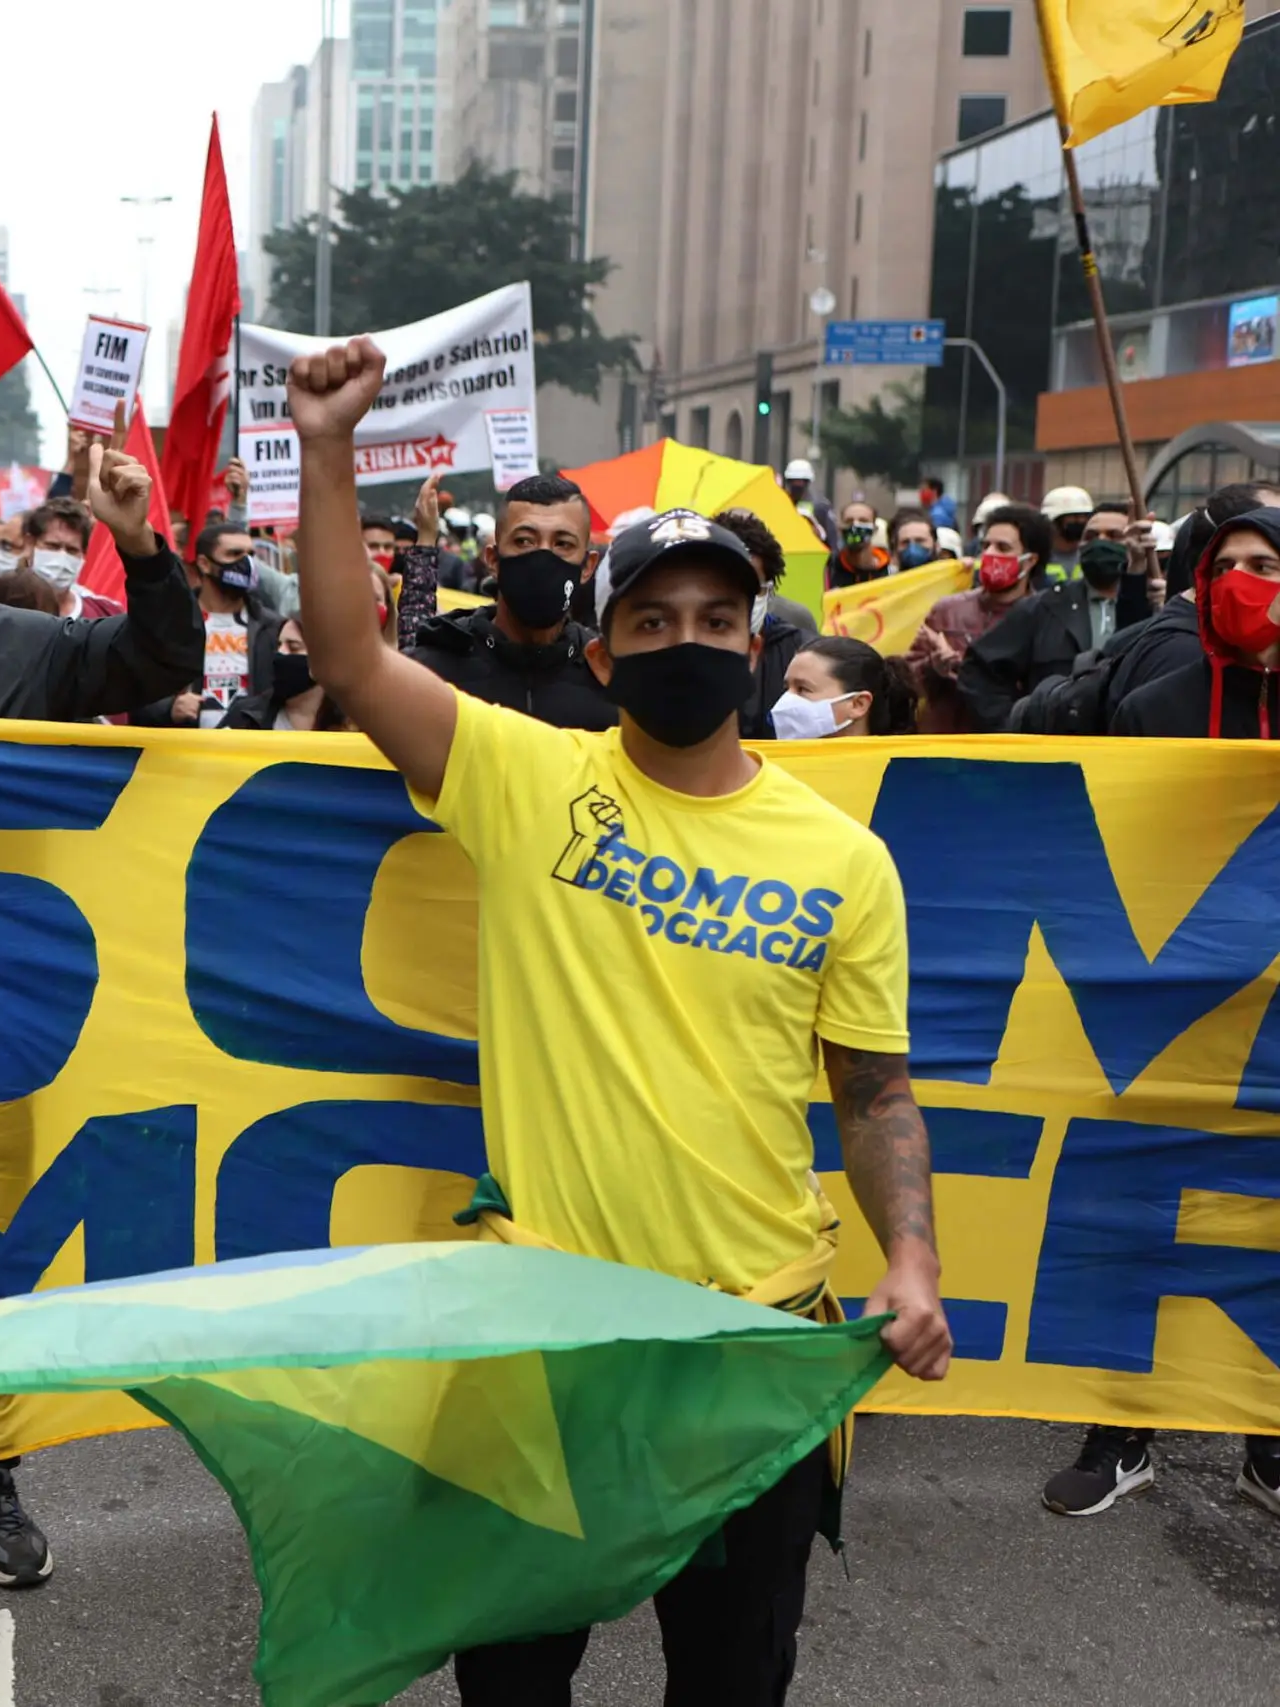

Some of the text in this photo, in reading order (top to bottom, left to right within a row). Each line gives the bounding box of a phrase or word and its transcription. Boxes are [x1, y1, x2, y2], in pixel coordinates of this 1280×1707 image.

[94, 332, 129, 363] FIM
[255, 440, 291, 462] FIM
[574, 858, 829, 973] DEOCRACIA
